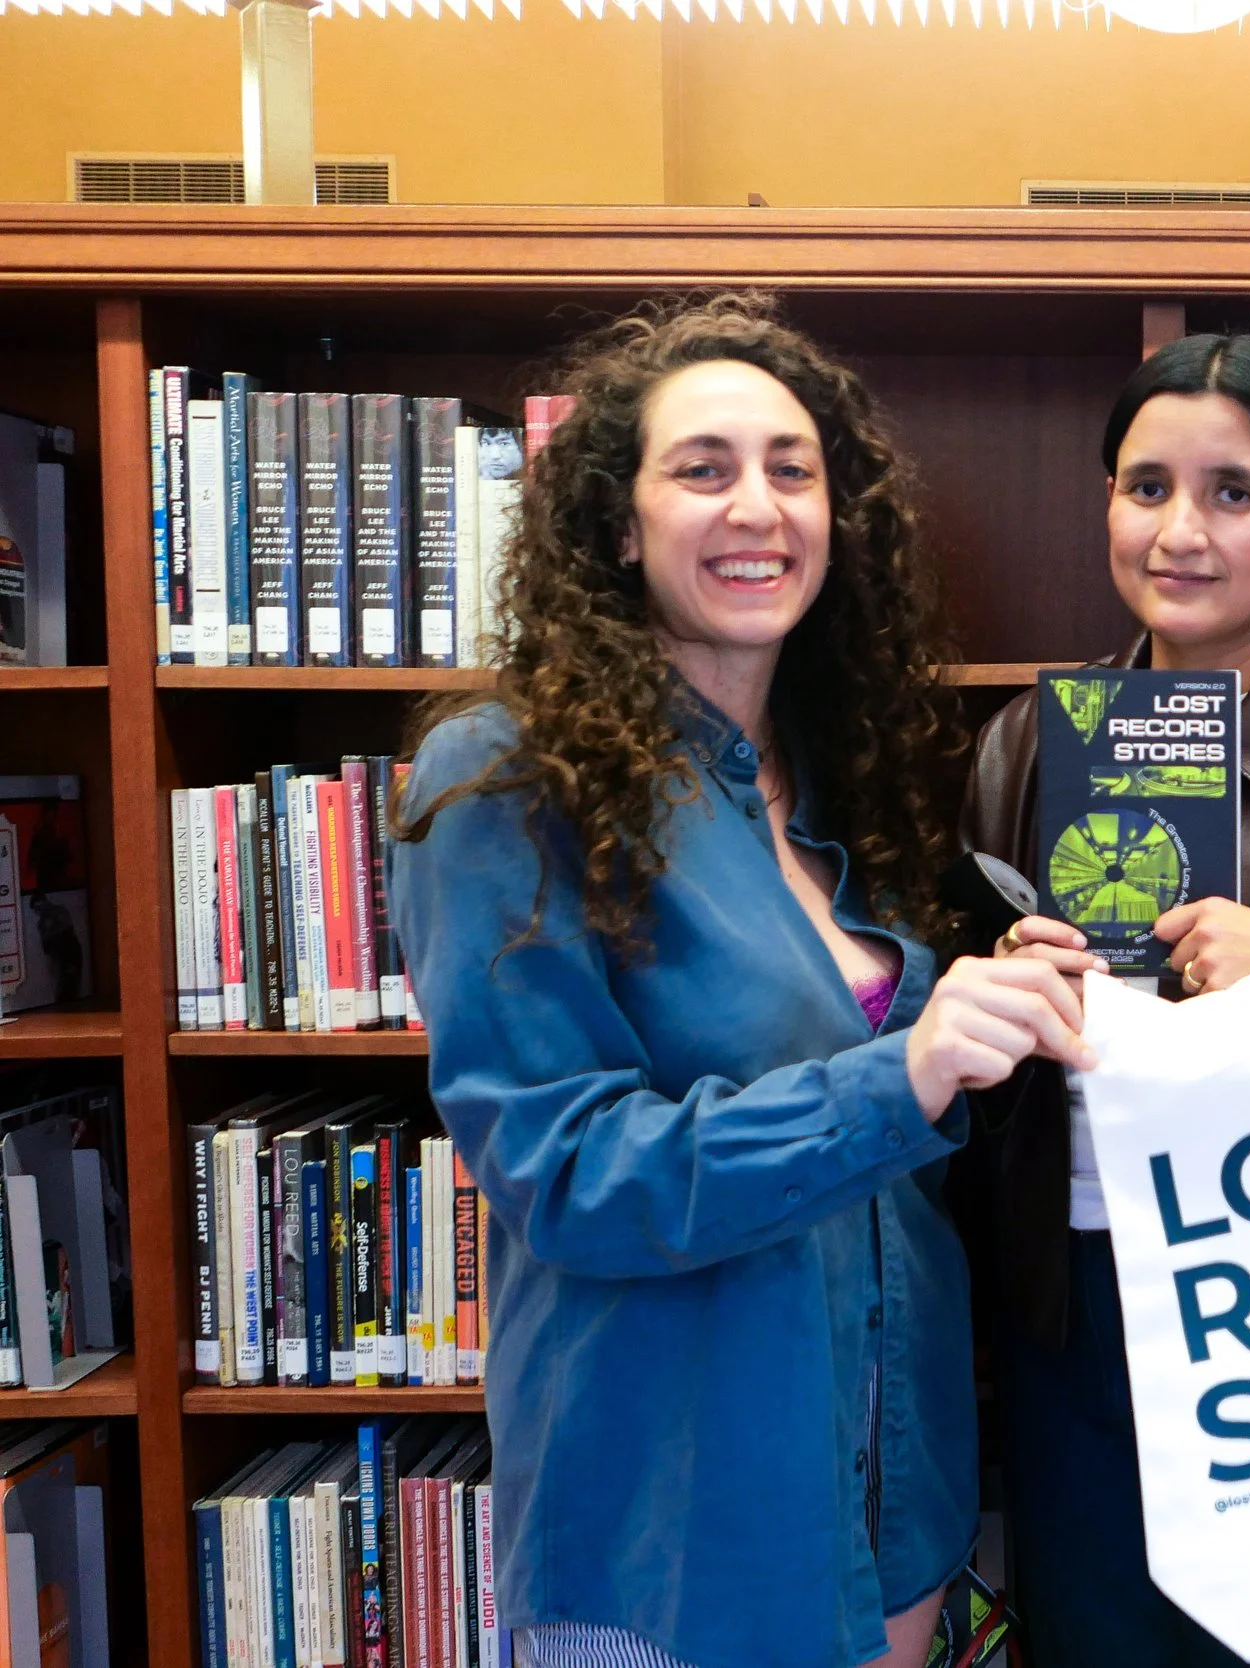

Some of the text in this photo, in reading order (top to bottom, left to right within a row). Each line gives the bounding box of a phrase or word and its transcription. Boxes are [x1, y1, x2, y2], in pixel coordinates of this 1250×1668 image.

[167, 377, 183, 435] ULTIMATE
[228, 386, 242, 525] Martial Arts for Women
[305, 462, 336, 470] WATER
[169, 438, 185, 500] Conditioning
[253, 472, 288, 480] MIRROR
[304, 472, 338, 480] MIRROR
[172, 501, 184, 515] for
[262, 516, 280, 524] LEE
[173, 517, 186, 552] Martial
[303, 527, 342, 535] AND THE
[304, 537, 340, 545] MAKING
[251, 547, 294, 555] OF ASIAN
[252, 557, 293, 565] AMERICA
[174, 553, 187, 575] Arts
[197, 549, 219, 584] CIRCLE
[256, 591, 289, 599] CHANG
[261, 581, 284, 589] JEFF
[312, 581, 334, 589] JEFF
[1174, 682, 1226, 690] VERSION 2.0
[1153, 695, 1227, 714] LOST
[1108, 719, 1226, 738] RECORD
[1113, 743, 1226, 762] STORES
[176, 826, 187, 839] IN
[195, 826, 206, 839] IN
[278, 817, 287, 840] Defend
[177, 842, 188, 866] THE
[196, 841, 206, 866] THE
[278, 841, 288, 866] Yourself
[305, 830, 318, 869] FIGHTING
[1148, 807, 1192, 888] The Greater Los
[223, 840, 234, 905] THE KARATE WAY
[178, 870, 189, 905] DOJO
[197, 869, 208, 904] DOJO
[307, 872, 321, 915] VISIBILITY
[350, 781, 372, 992] The Techniques of Championship Wrestling
[293, 859, 307, 961] TEACHING SELF-DEFENSE
[1126, 948, 1146, 956] MAP
[195, 1139, 207, 1178] WHY
[332, 1140, 341, 1157] JON
[284, 1149, 300, 1236] LOU REED
[333, 1159, 341, 1202] ROBINSON
[196, 1193, 208, 1243] FIGHT
[242, 1137, 259, 1347] SELF-DEFENSE FOR WOMEN THE WEST POINT
[455, 1195, 475, 1292] UNCAGED
[356, 1221, 370, 1293] Self-Defense
[199, 1265, 210, 1286] BJ
[335, 1262, 343, 1279] THE
[336, 1280, 344, 1311] FUTURE
[200, 1290, 212, 1334] PENN
[361, 1460, 376, 1551] KICKING DOWN DOORS
[324, 1529, 333, 1547] Fight
[383, 1463, 399, 1633] THE SECRET TEACHINGS
[324, 1547, 334, 1568] Sports
[481, 1494, 495, 1629] THE ART AND SCIENCE OF JUDO
[327, 1568, 335, 1581] and
[327, 1582, 336, 1613] American
